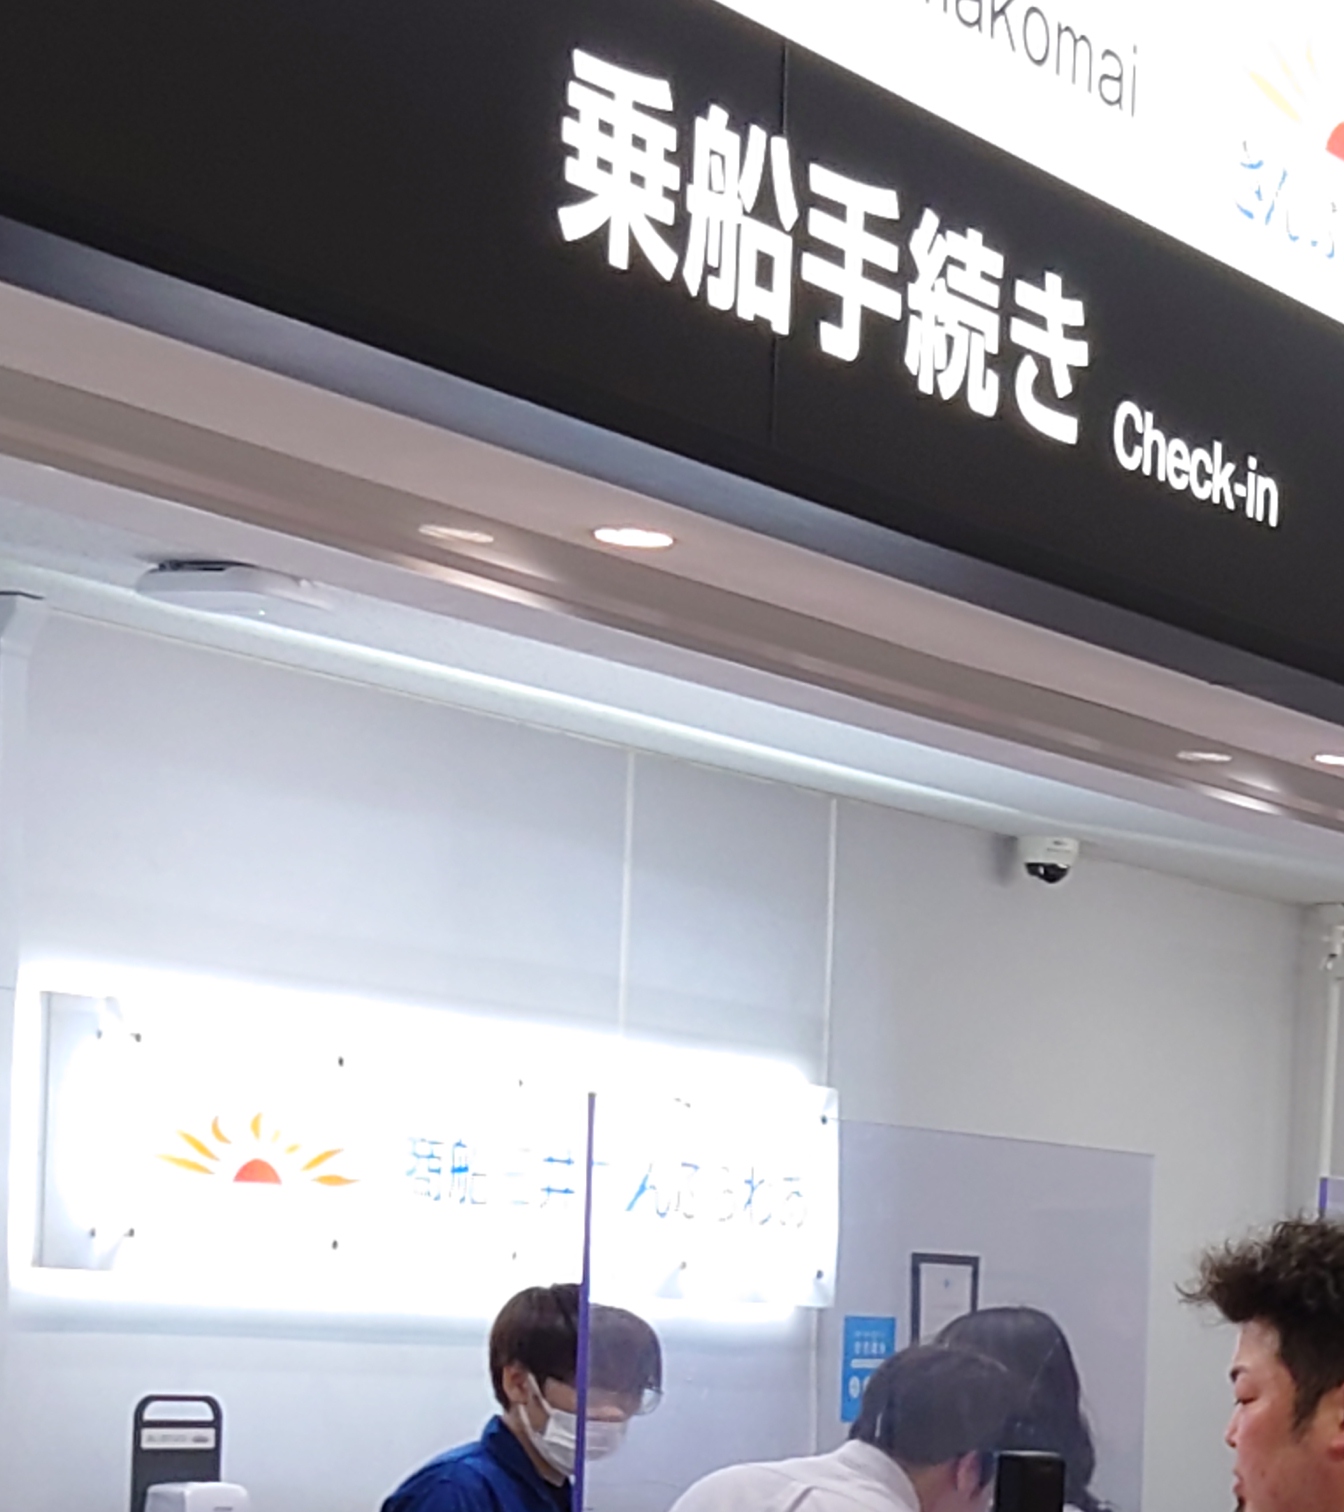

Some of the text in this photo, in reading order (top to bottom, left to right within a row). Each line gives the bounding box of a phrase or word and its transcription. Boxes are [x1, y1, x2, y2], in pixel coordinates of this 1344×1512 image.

[924, 0, 1137, 117] akomai
[557, 47, 1090, 446] 乗船手続き
[1111, 400, 1280, 529] Check-in
